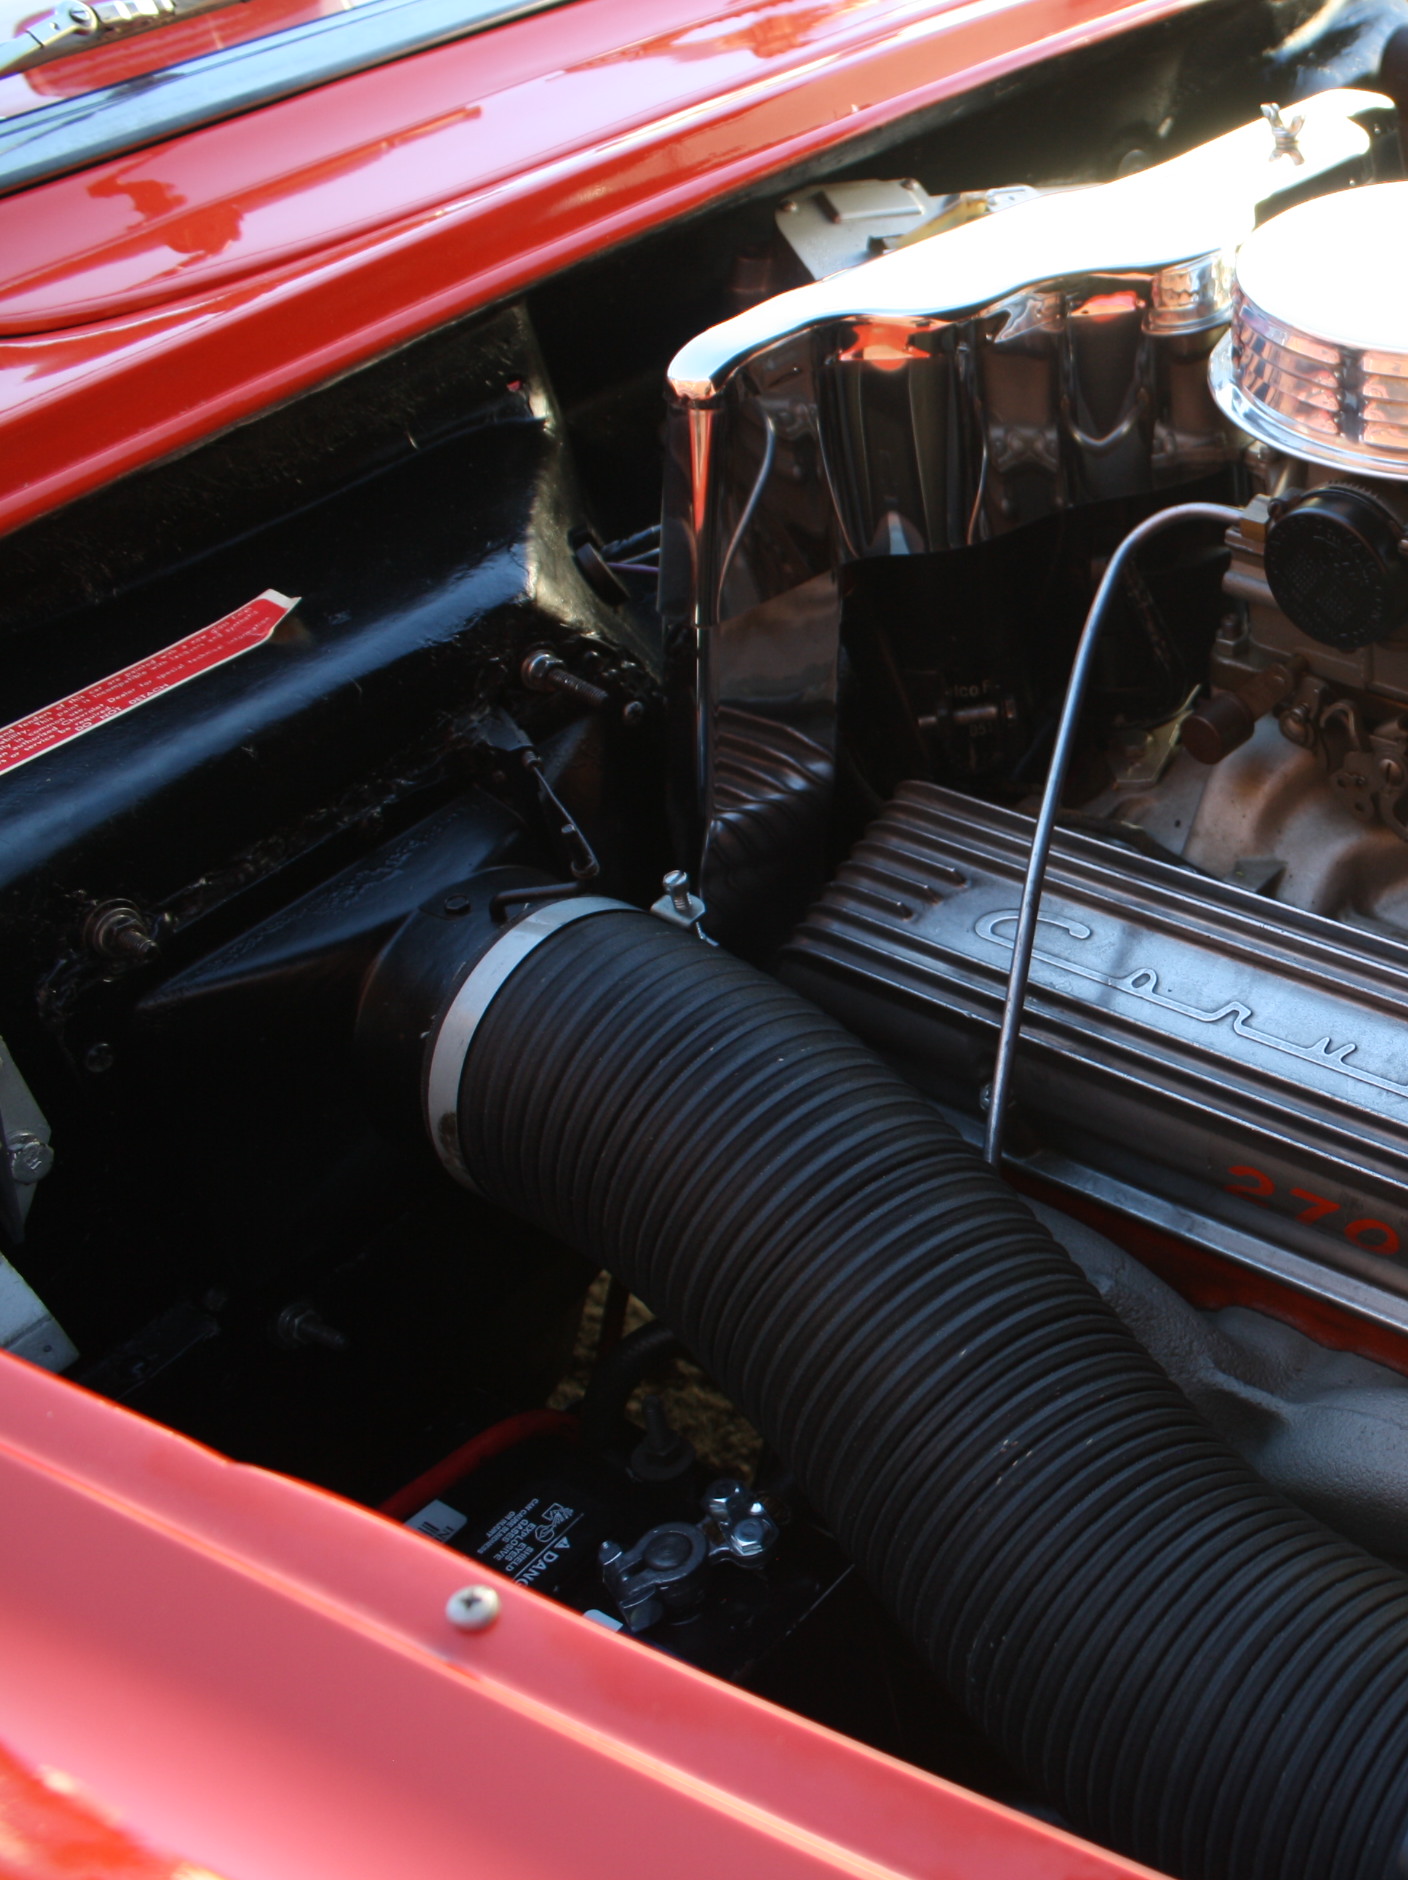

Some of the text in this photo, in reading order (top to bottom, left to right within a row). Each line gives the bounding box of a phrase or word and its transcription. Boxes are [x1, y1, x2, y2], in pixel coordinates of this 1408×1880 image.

[12, 725, 58, 751] authorized
[61, 703, 105, 726] Chevrolet
[107, 688, 136, 703] Dealer
[18, 711, 52, 728] fenders
[56, 702, 65, 711] of
[74, 683, 170, 733] DO NOT DETACH
[28, 718, 65, 737] common
[34, 716, 54, 727] This
[24, 734, 56, 751] service
[1224, 1165, 1400, 1256] 270
[525, 1497, 540, 1511] CAN
[493, 1521, 537, 1562] EXPLOSIVE
[501, 1517, 529, 1544] GASES
[504, 1541, 527, 1562] EYES
[504, 1545, 535, 1573] SHIELD
